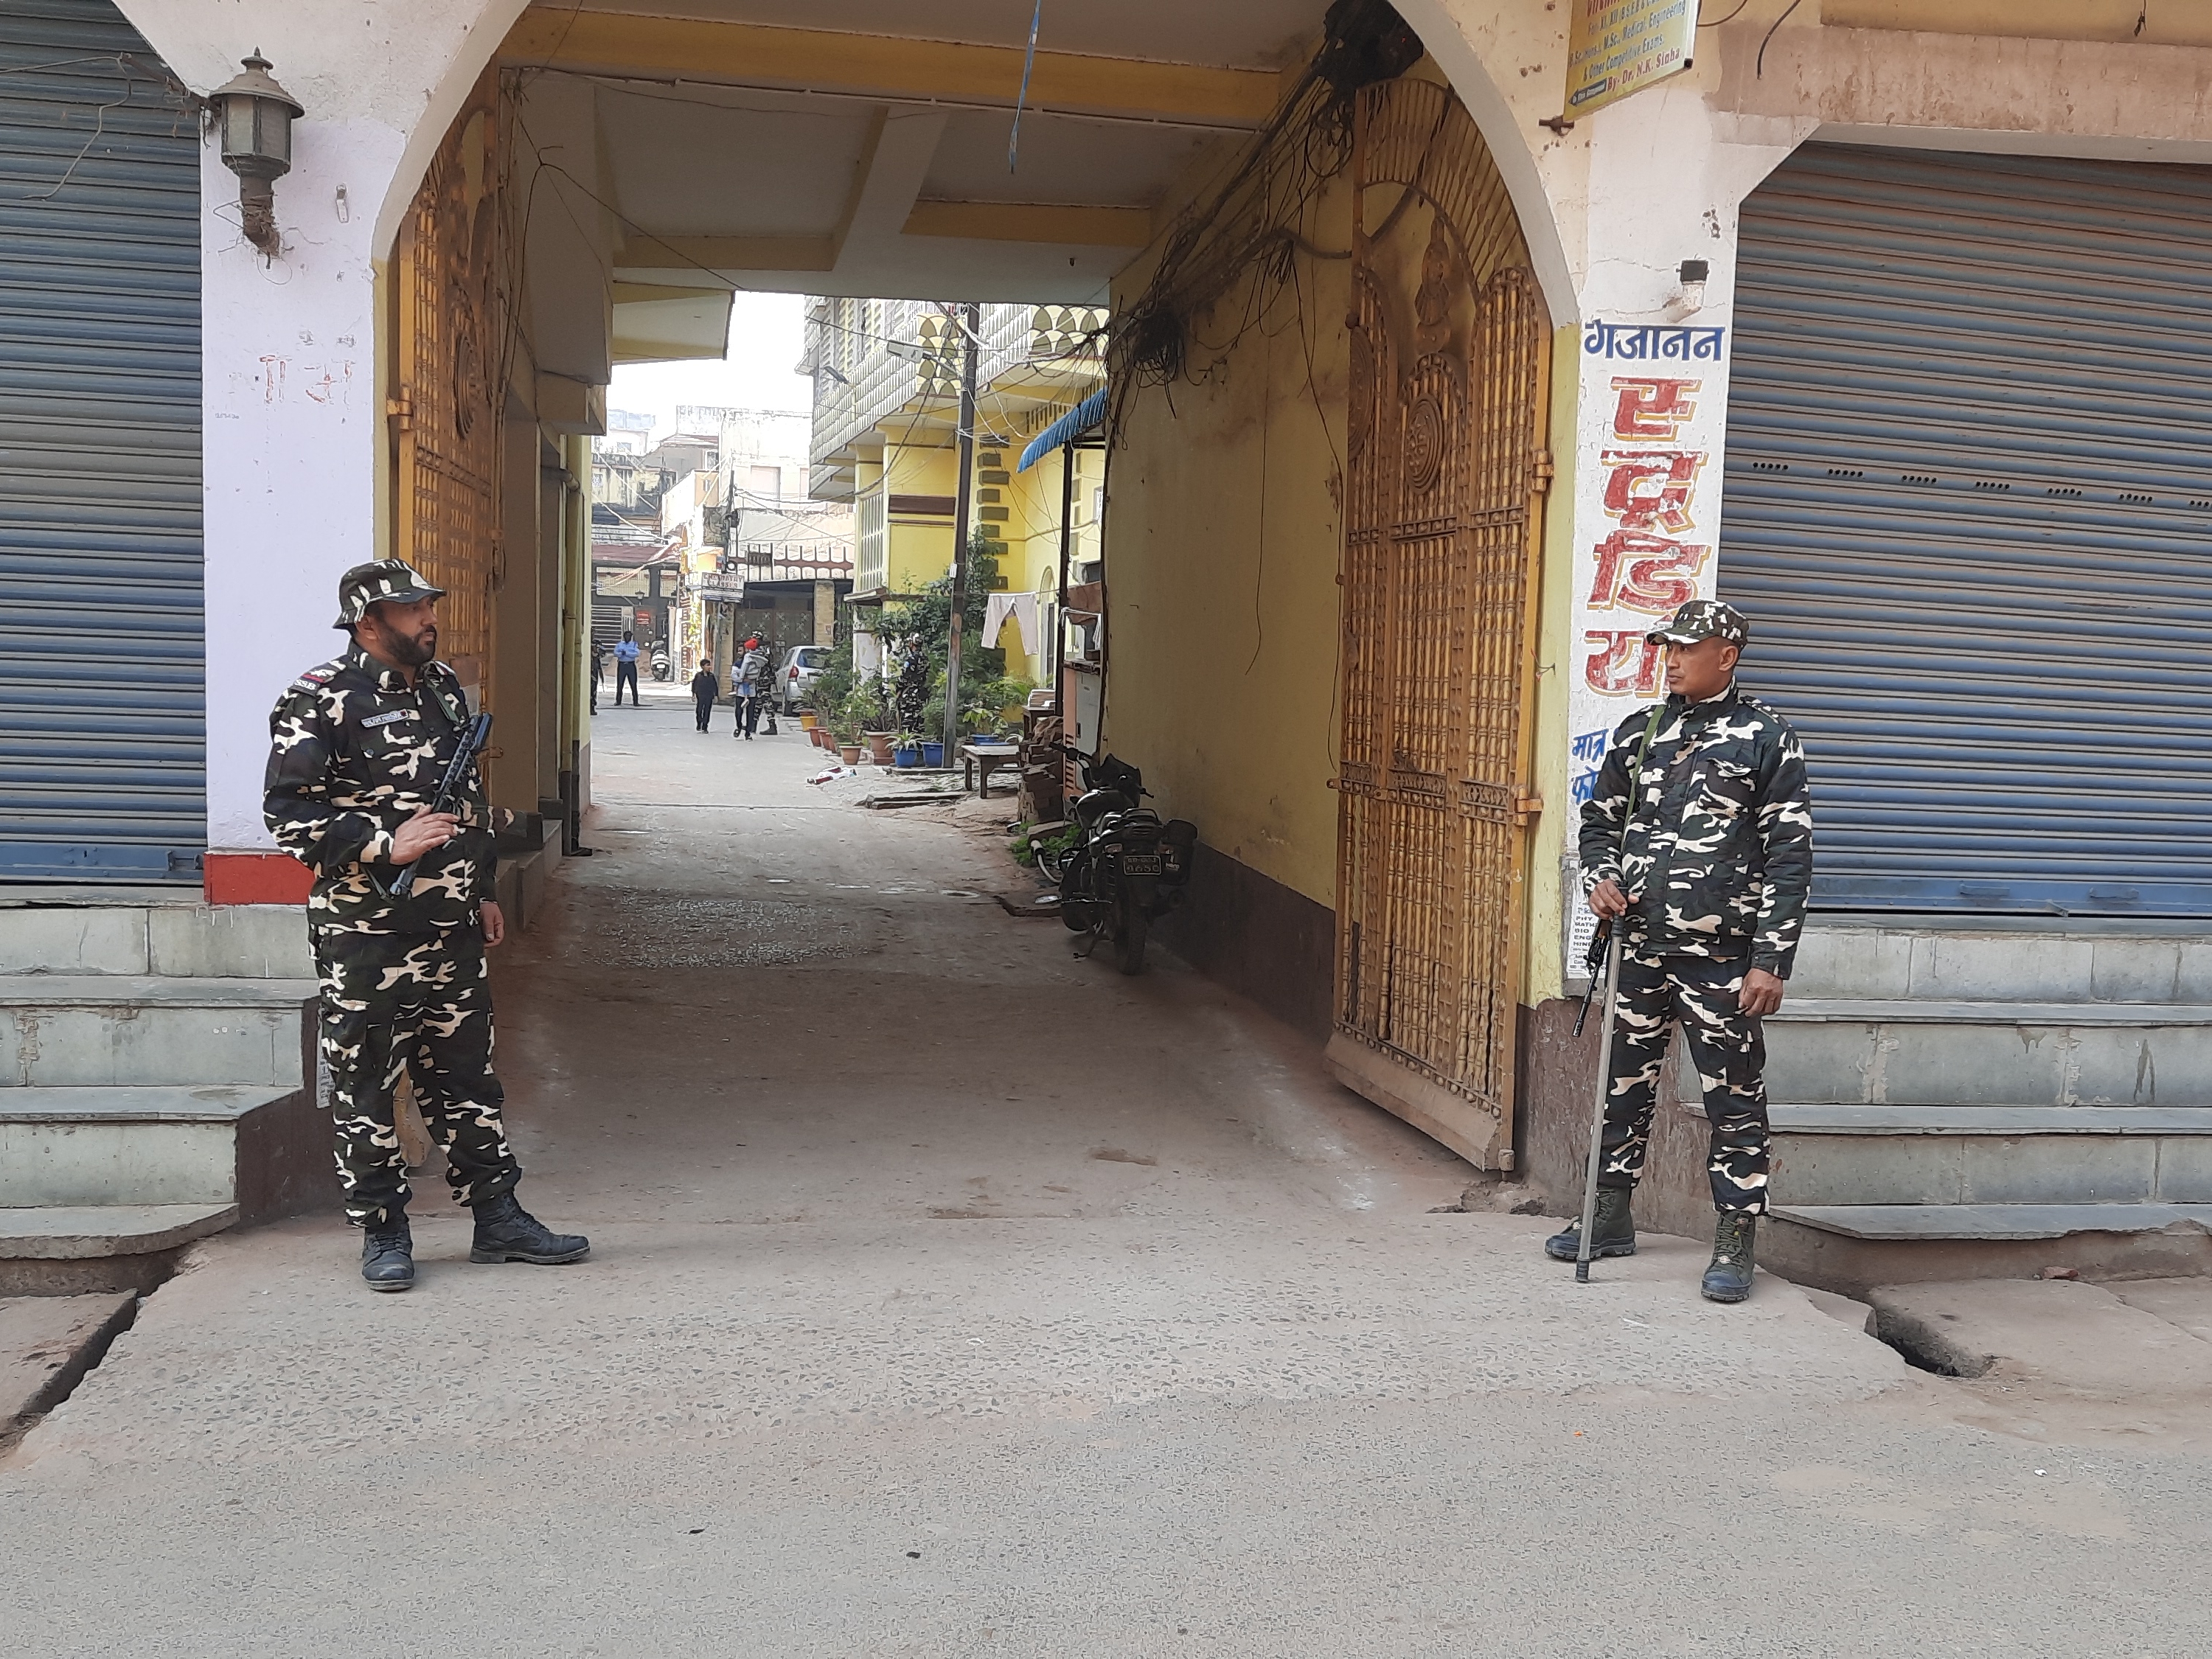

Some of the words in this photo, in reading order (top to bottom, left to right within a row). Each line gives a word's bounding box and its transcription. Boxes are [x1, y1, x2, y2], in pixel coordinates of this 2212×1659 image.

[1606, 48, 1641, 72] Competitive
[1655, 47, 1680, 69] Sinha
[1584, 318, 1726, 361] गजानन
[295, 678, 316, 691] SSB
[1572, 728, 1609, 762] मात्र
